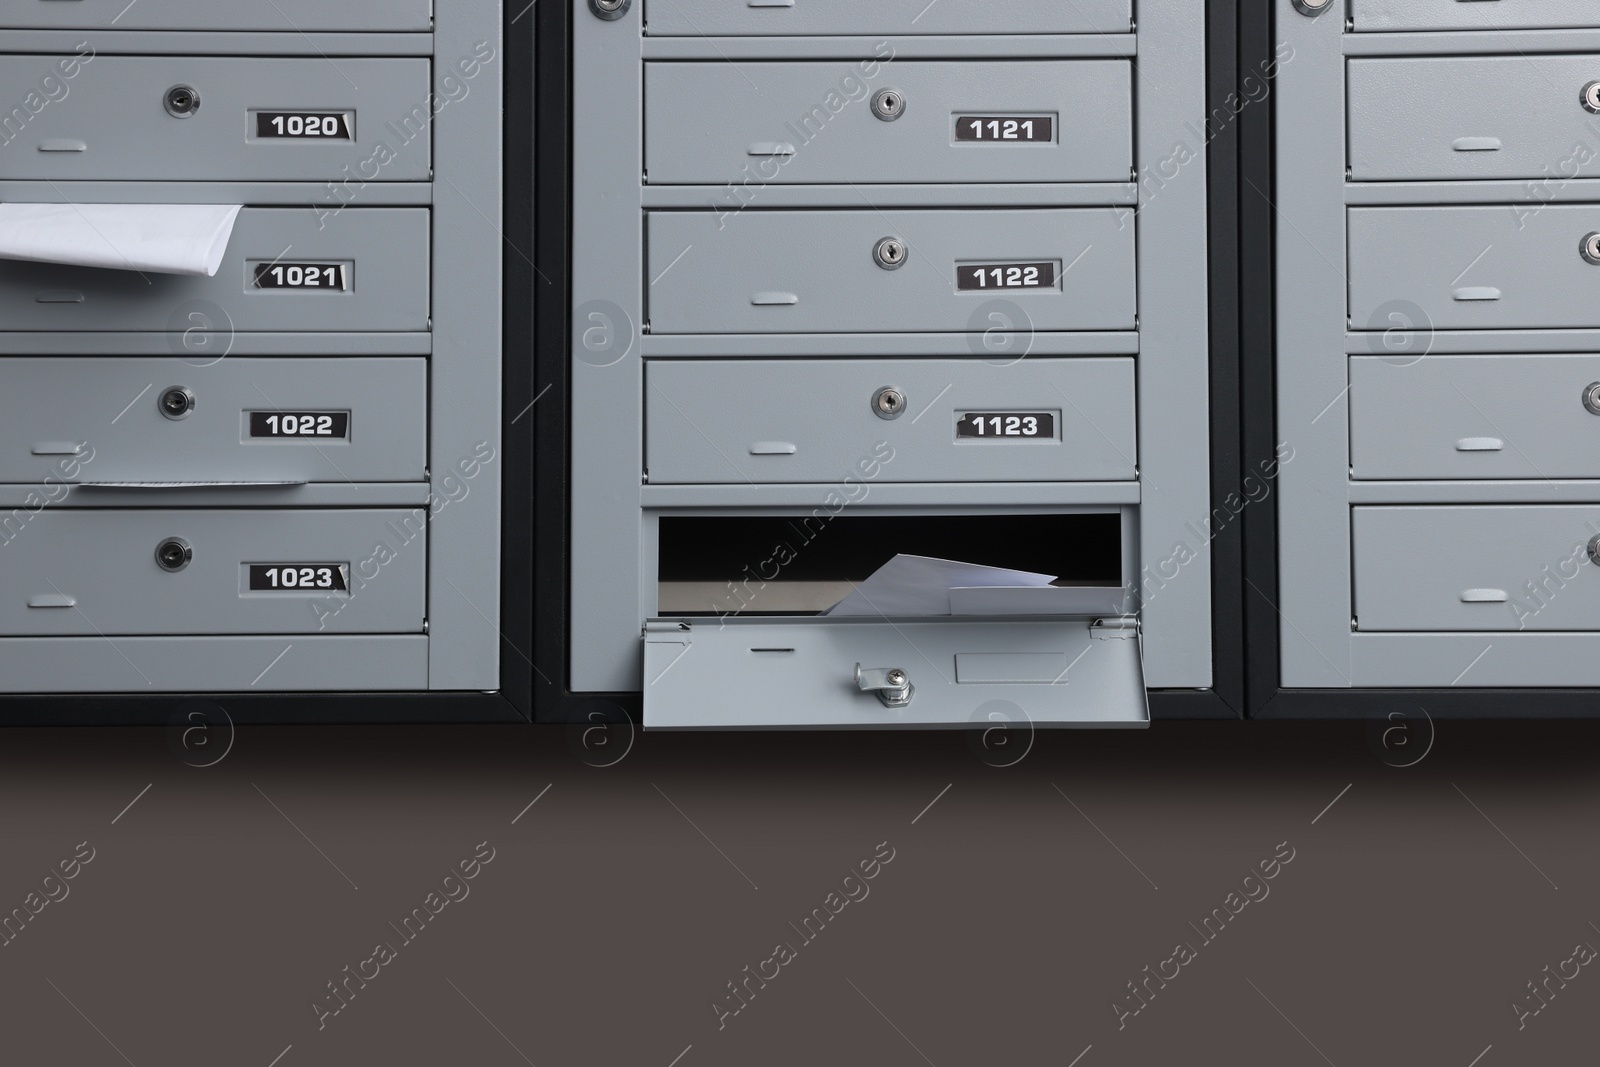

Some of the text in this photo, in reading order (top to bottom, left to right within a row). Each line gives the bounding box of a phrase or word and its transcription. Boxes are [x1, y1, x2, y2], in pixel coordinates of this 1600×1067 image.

[271, 116, 338, 136] 1020
[969, 120, 1033, 139] 1121
[270, 266, 335, 286] 1021
[972, 267, 1039, 287] 1122
[265, 415, 333, 435] 1022
[971, 416, 1038, 436] 1123
[265, 568, 332, 587] 1023
